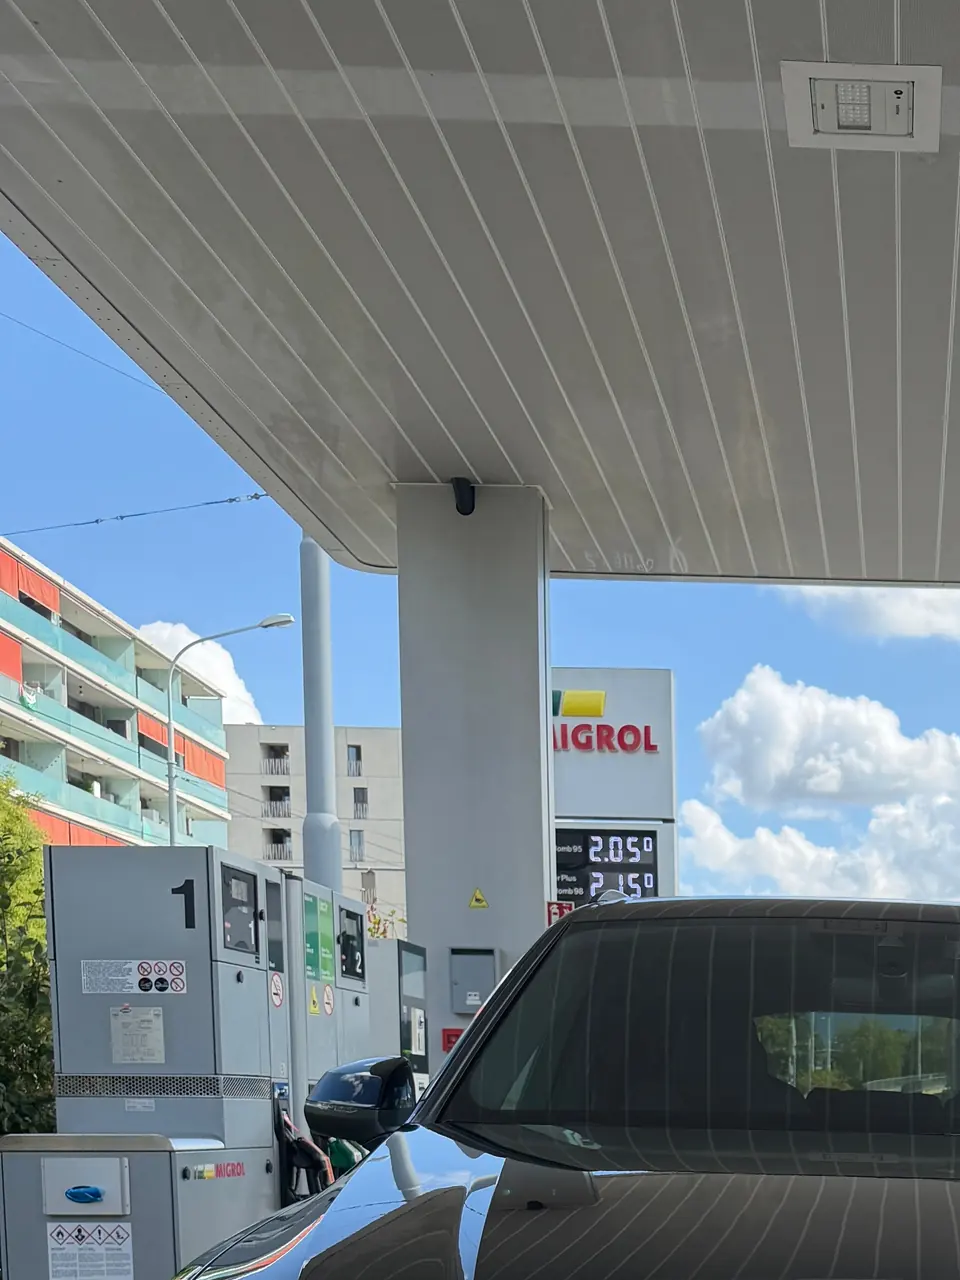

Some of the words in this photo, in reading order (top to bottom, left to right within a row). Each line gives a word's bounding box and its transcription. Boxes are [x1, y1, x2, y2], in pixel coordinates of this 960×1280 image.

[553, 723, 659, 752] IGROL
[171, 879, 196, 929] 1
[248, 920, 255, 945] 1
[355, 951, 362, 973] 2
[215, 1161, 246, 1178] MIGROL
